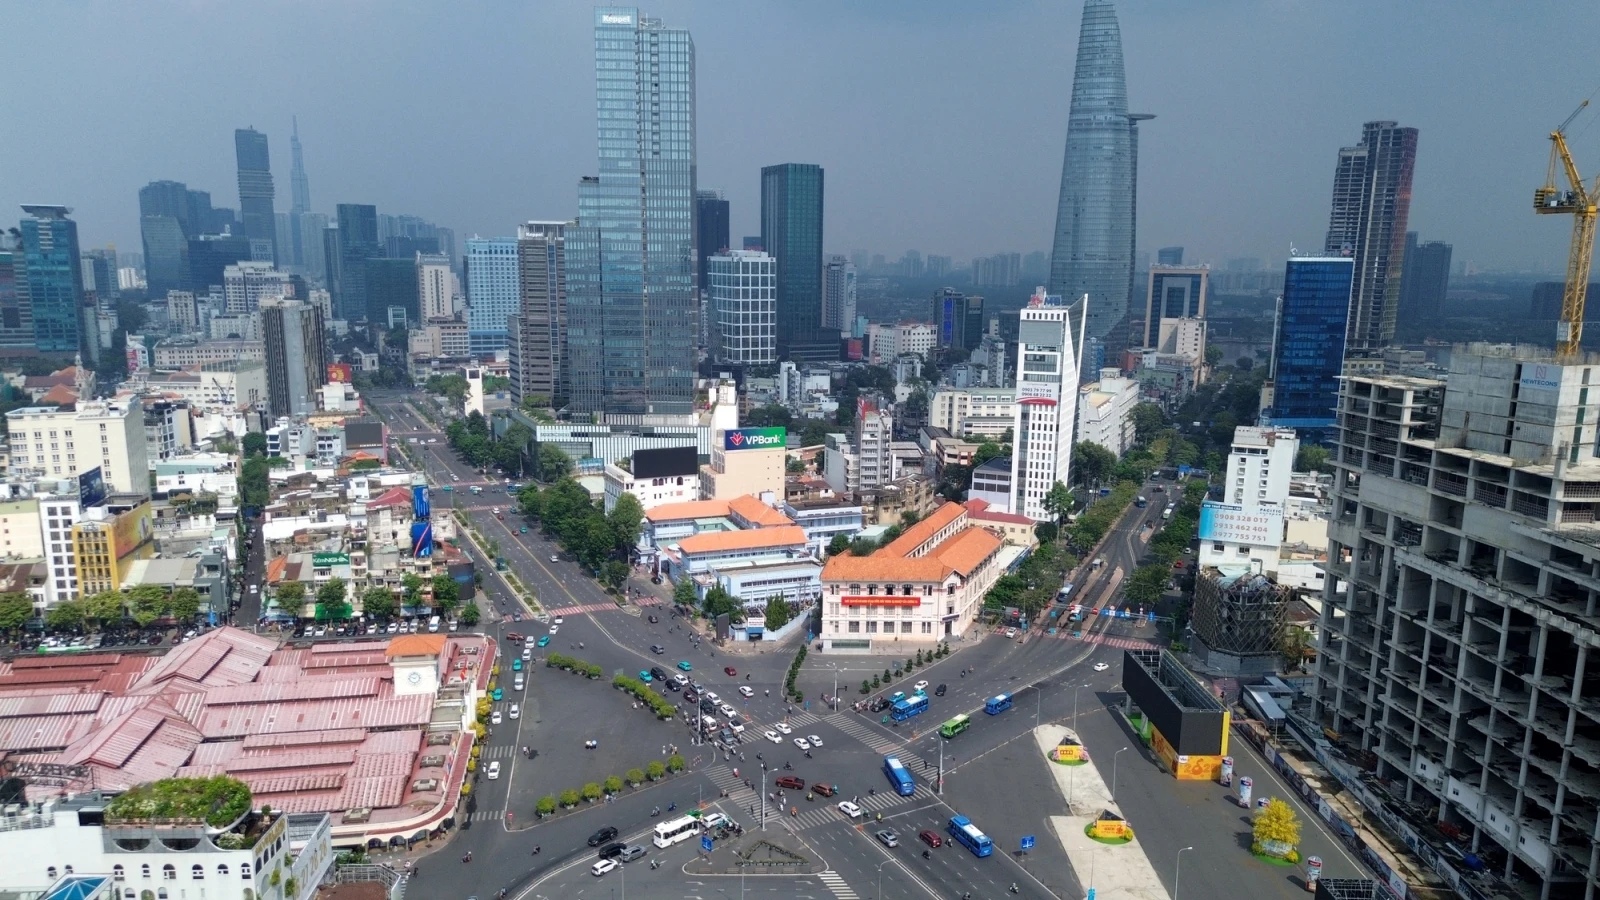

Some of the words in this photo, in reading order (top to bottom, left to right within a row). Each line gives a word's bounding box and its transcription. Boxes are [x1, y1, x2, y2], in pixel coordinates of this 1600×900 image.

[603, 15, 630, 23] Keppel
[1521, 378, 1558, 387] NEWTECONS
[746, 435, 781, 445] VPBank
[1214, 513, 1235, 521] 0908
[1234, 533, 1250, 541] 755
